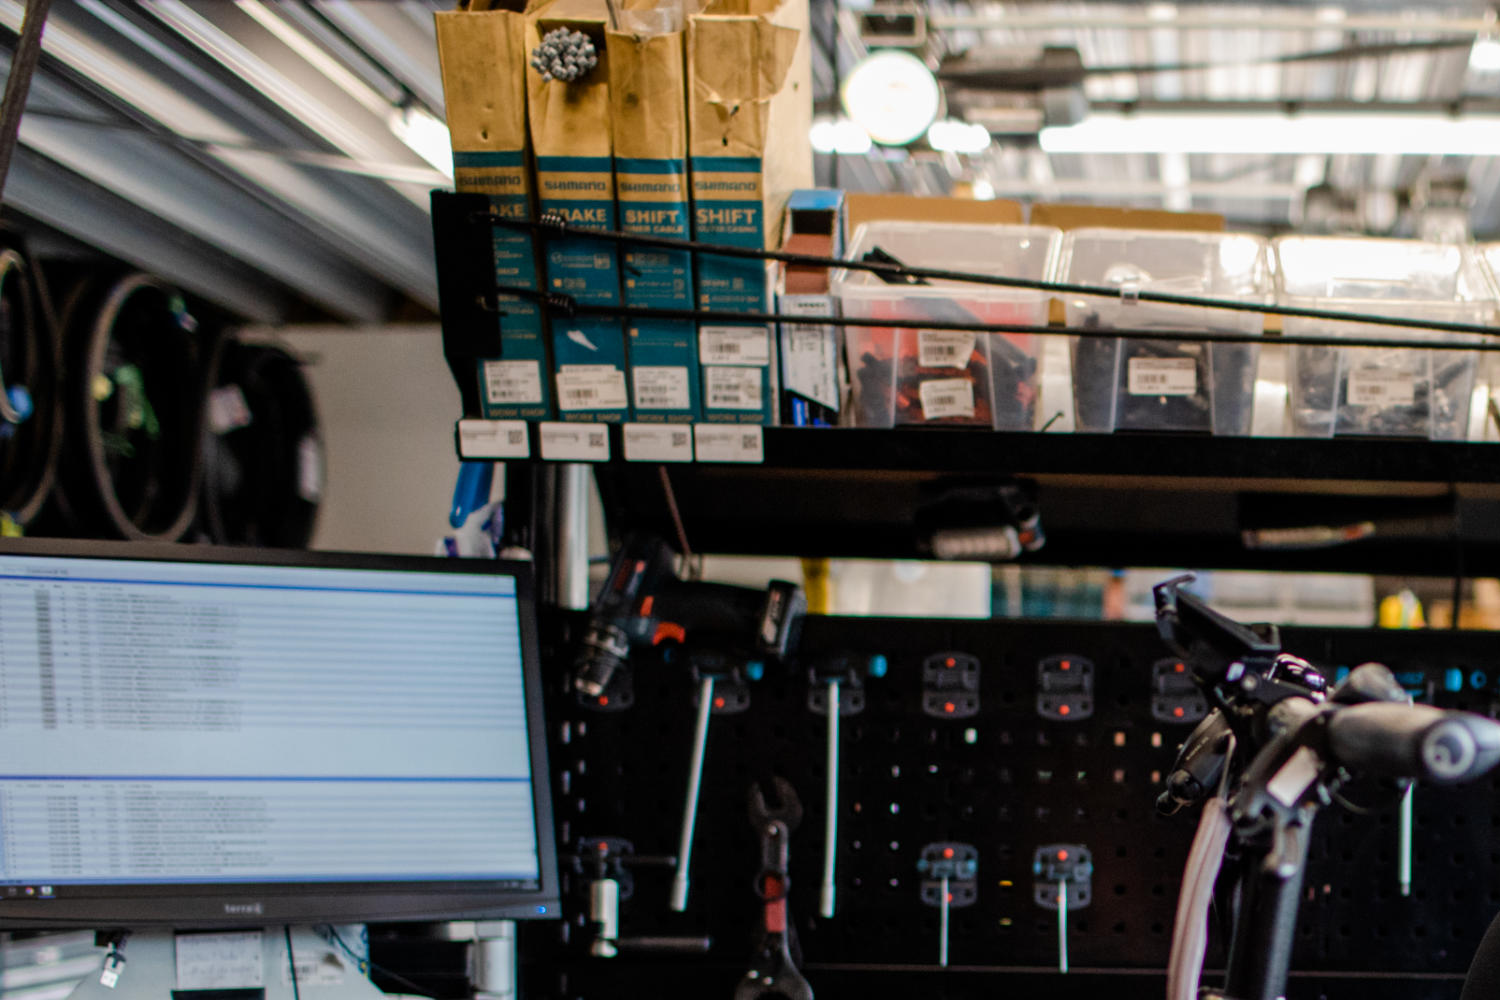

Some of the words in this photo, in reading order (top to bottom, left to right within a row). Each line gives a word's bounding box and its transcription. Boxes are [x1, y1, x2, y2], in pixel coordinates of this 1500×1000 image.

[459, 175, 521, 187] SHIMANO
[544, 180, 607, 191] SHIMANO
[620, 181, 680, 193] SHIMANO
[695, 180, 757, 192] SHIMANO
[625, 210, 679, 224] SHIFT
[696, 208, 757, 225] SHIFT
